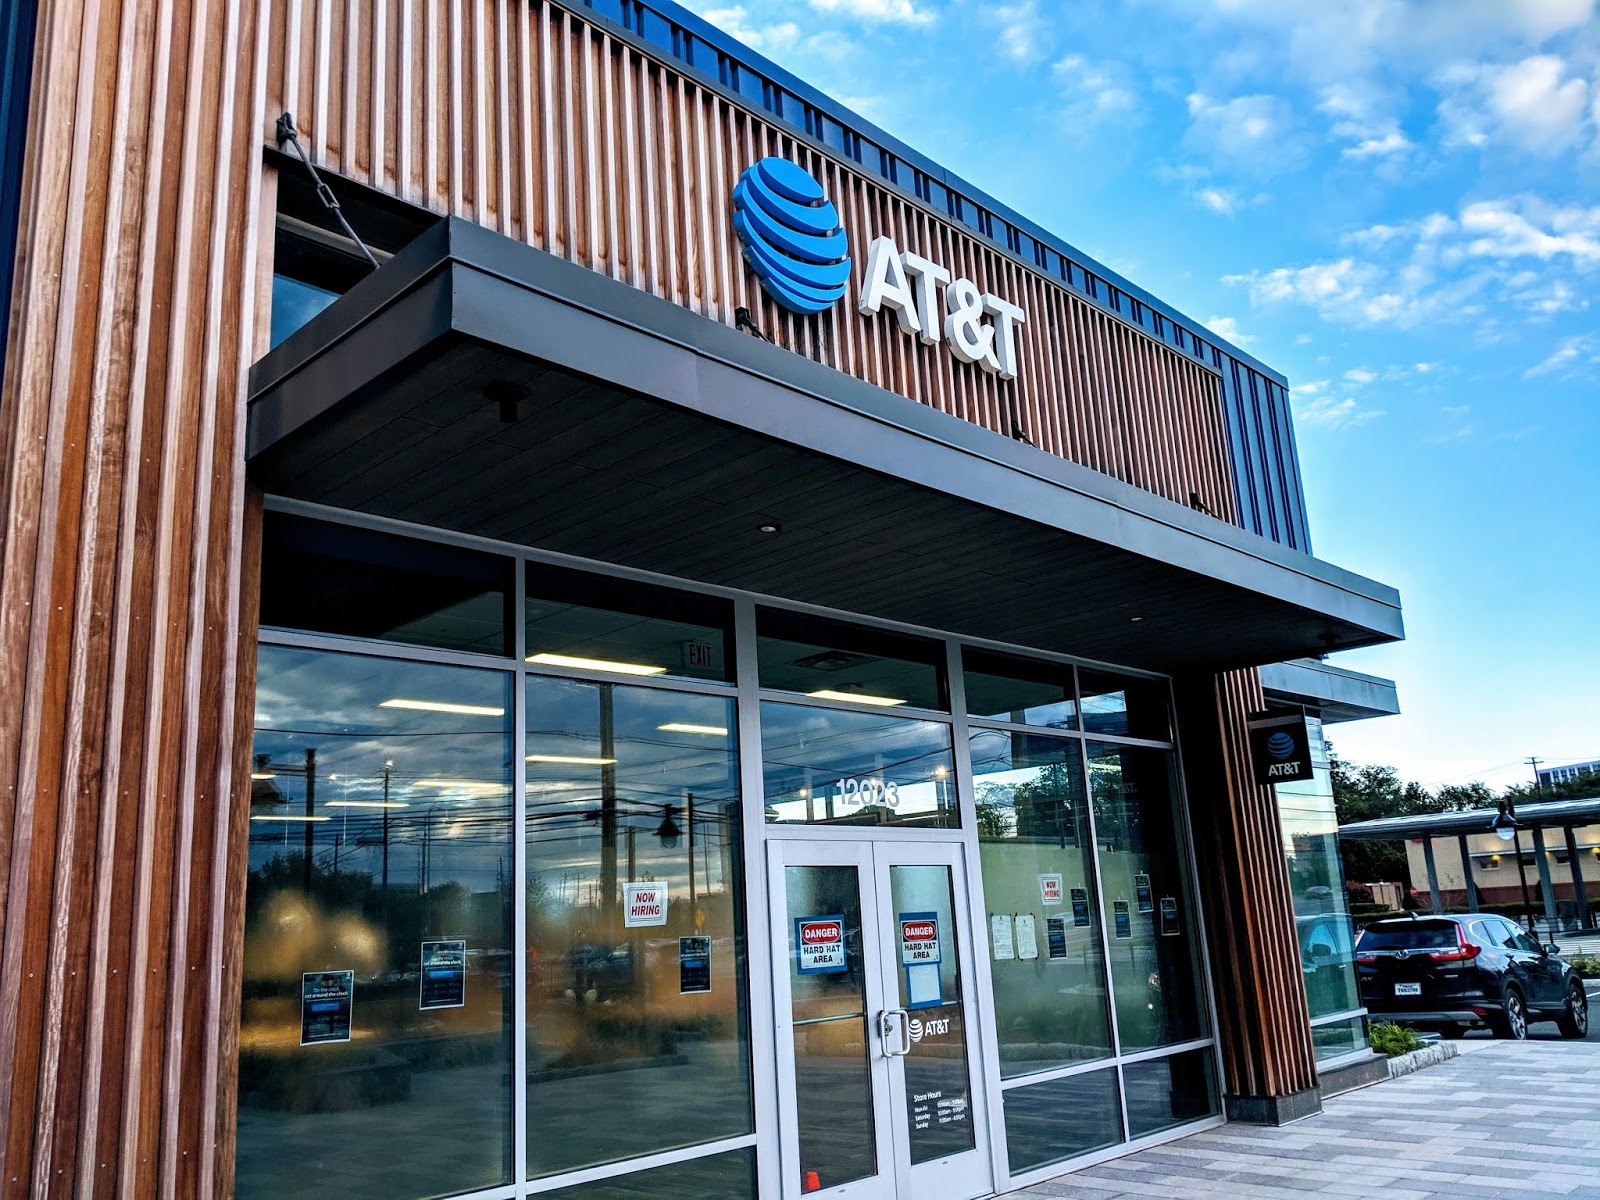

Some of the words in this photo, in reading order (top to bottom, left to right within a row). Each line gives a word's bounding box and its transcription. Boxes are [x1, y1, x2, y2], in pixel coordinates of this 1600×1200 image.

[859, 235, 1025, 380] AT&T
[689, 642, 712, 667] EXIT
[1268, 761, 1301, 777] AT&T
[836, 778, 900, 808] 12023
[636, 892, 656, 903] NOW
[631, 904, 660, 916] HIRING
[804, 927, 839, 939] DANGER
[905, 926, 934, 937] DANGER
[803, 945, 824, 955] HARD
[826, 944, 841, 953] HAT
[904, 942, 923, 951] HARD
[923, 941, 937, 950] HAT
[813, 954, 834, 964] AREA
[912, 951, 930, 960] AREA
[925, 1019, 950, 1037] AT&T
[914, 1094, 927, 1102] Store
[927, 1091, 941, 1099] Hours
